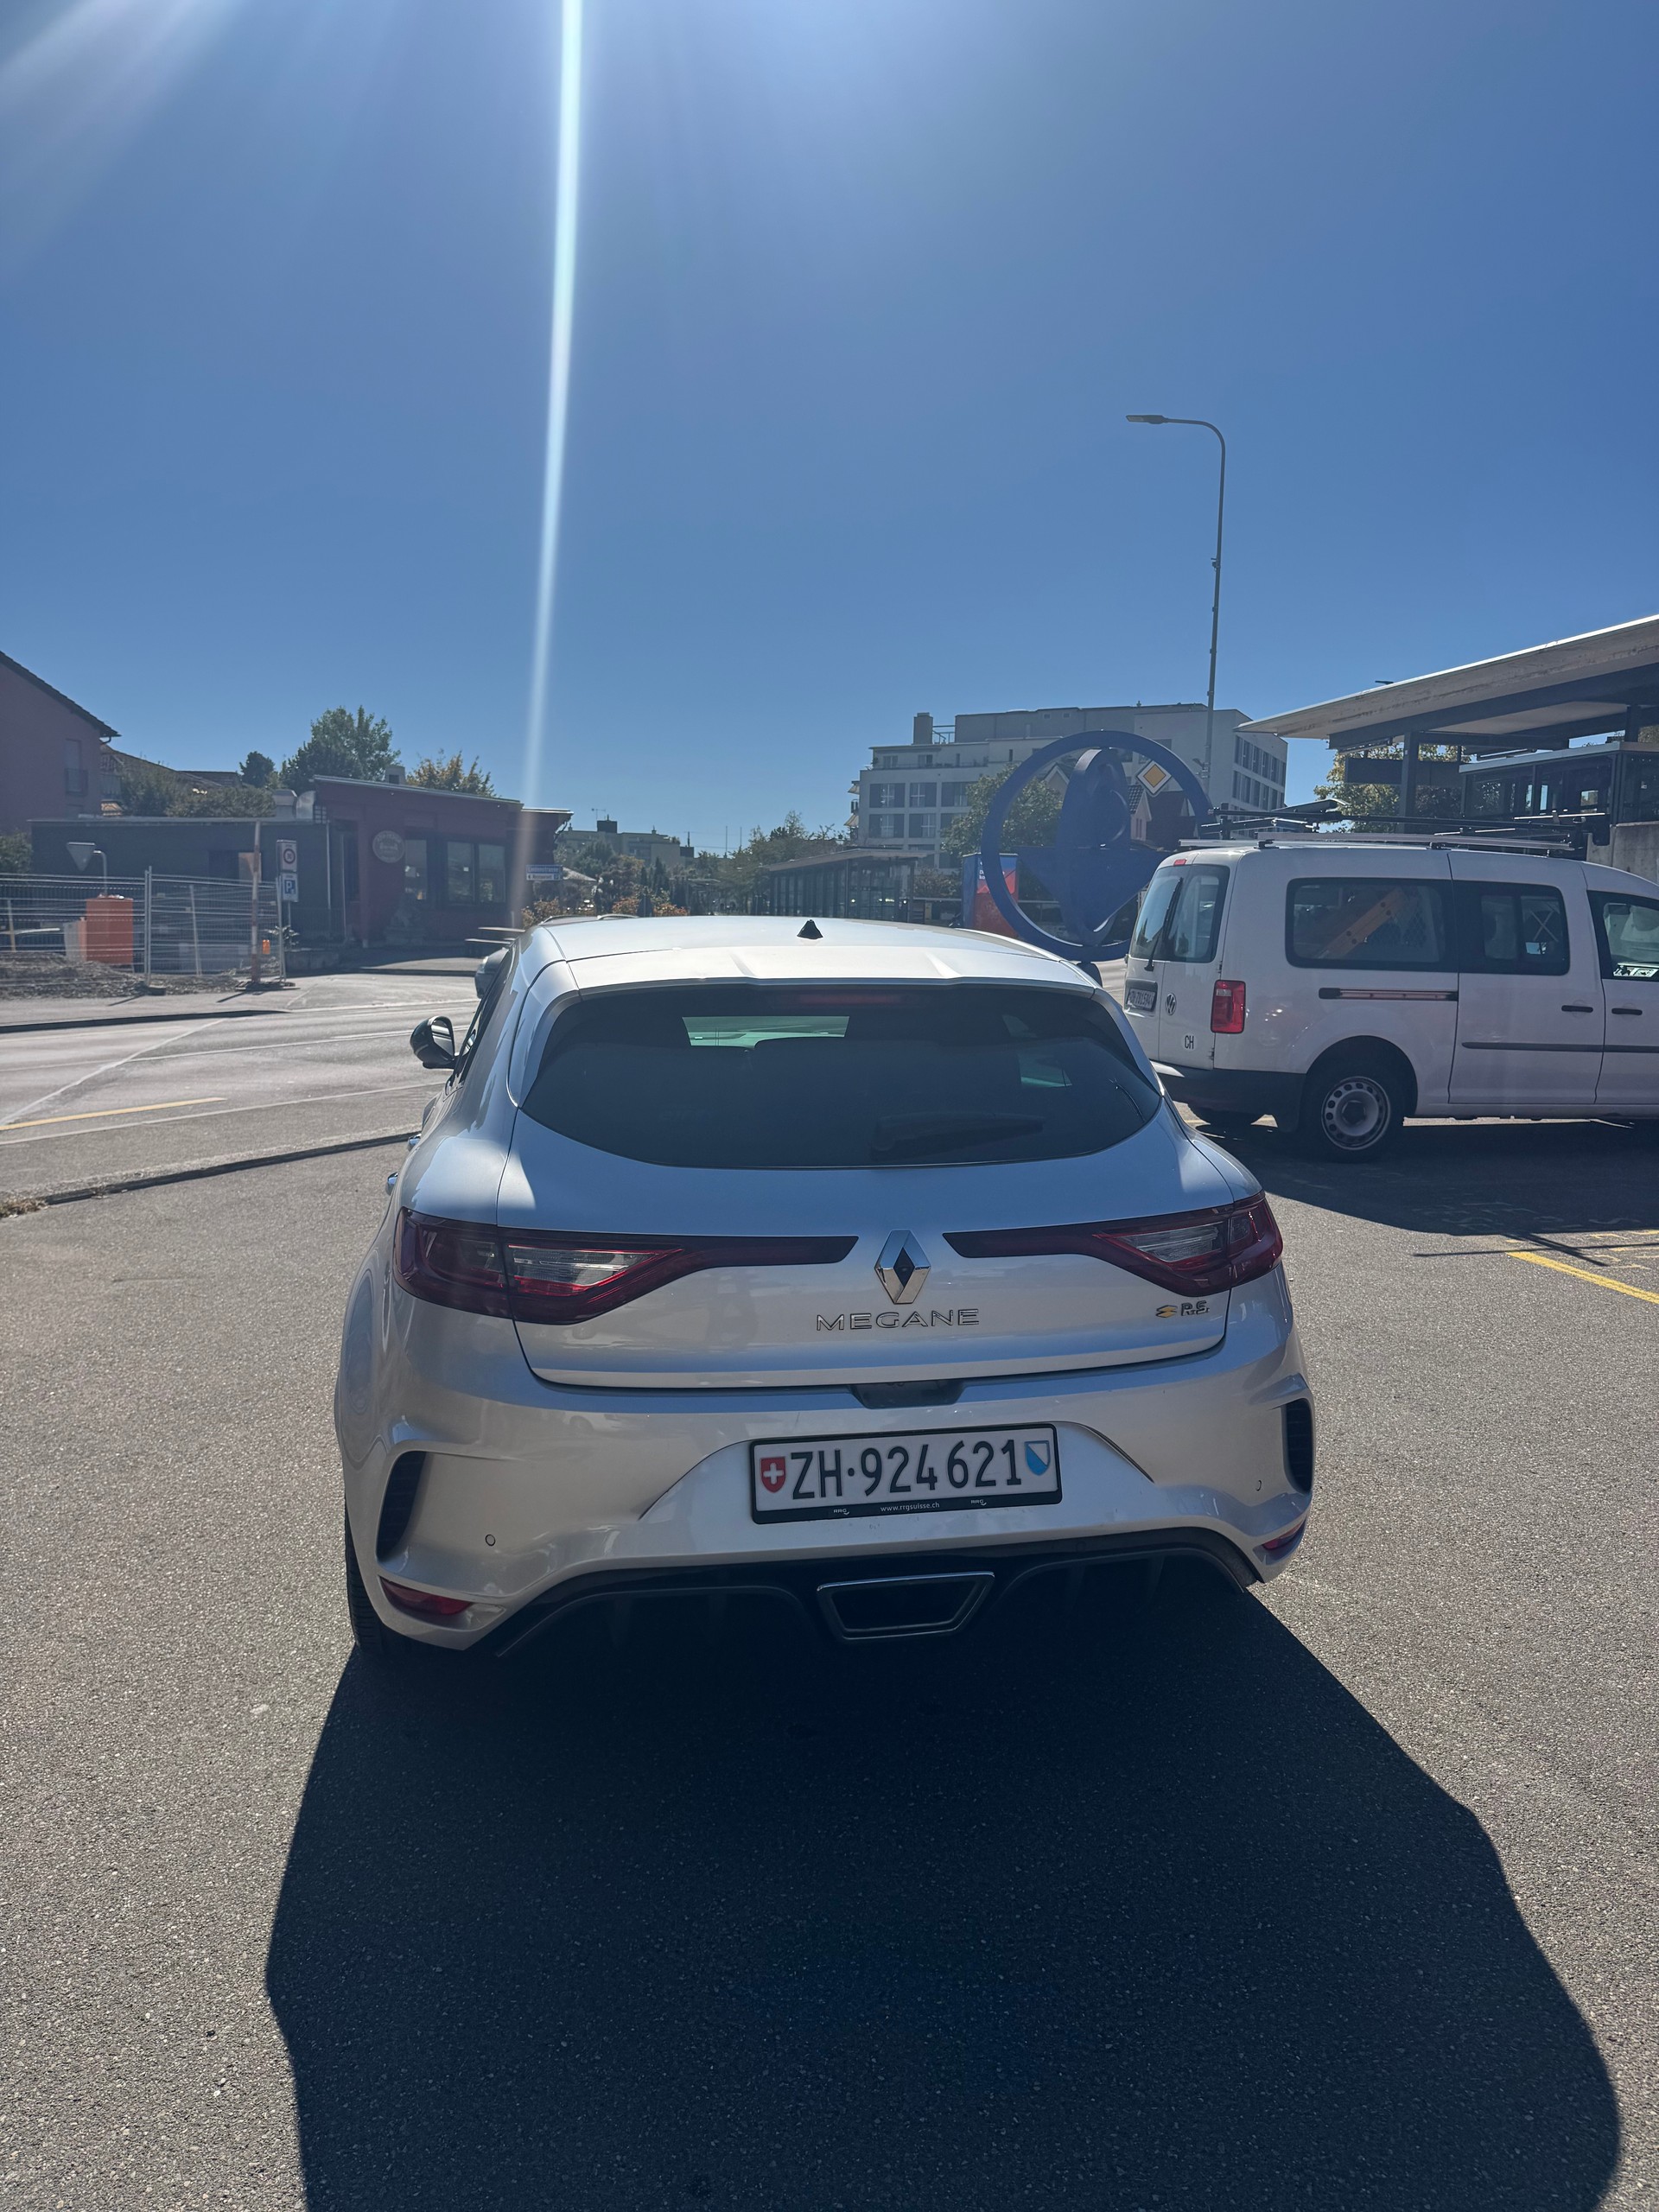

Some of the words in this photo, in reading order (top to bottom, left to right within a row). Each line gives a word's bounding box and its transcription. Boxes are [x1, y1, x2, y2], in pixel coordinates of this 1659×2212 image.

[1184, 1035, 1194, 1050] CH
[817, 1308, 979, 1331] MEGANE
[880, 1502, 940, 1512] www.rrgsuisse.ch
